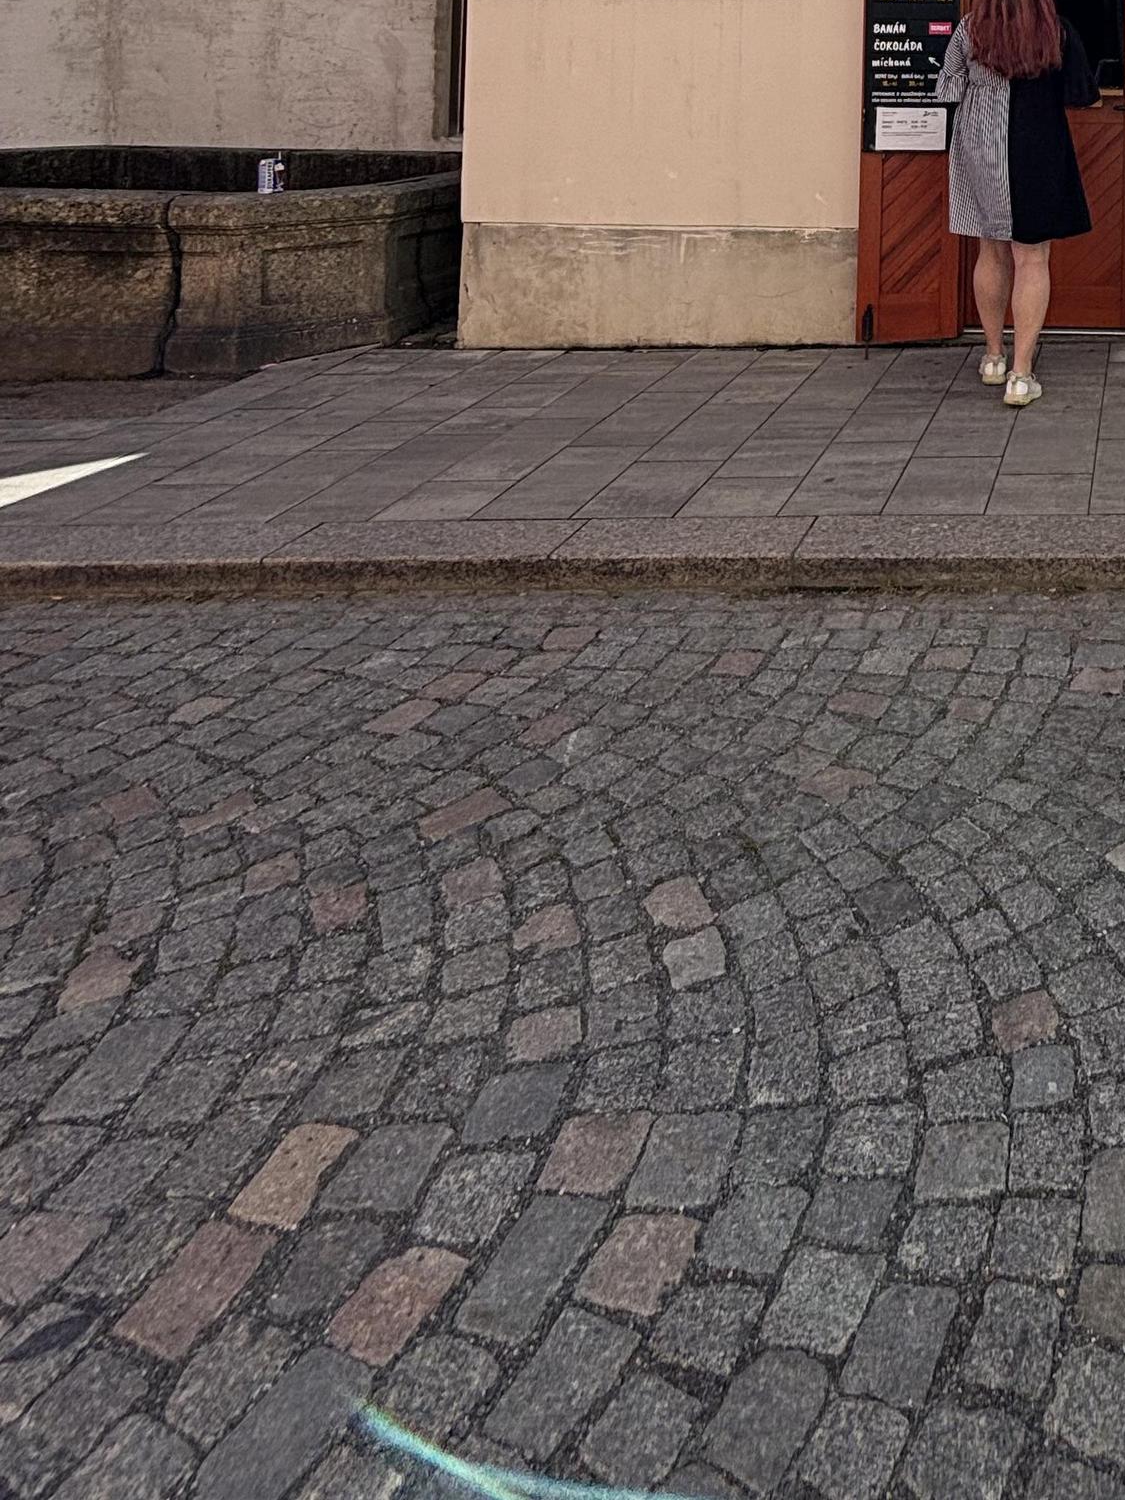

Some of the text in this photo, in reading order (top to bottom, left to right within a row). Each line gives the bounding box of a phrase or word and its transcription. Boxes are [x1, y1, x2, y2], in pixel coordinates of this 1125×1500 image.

[873, 21, 906, 34] BANÁN
[874, 39, 923, 51] ČOKOLÁDA
[872, 57, 911, 67] míchaná
